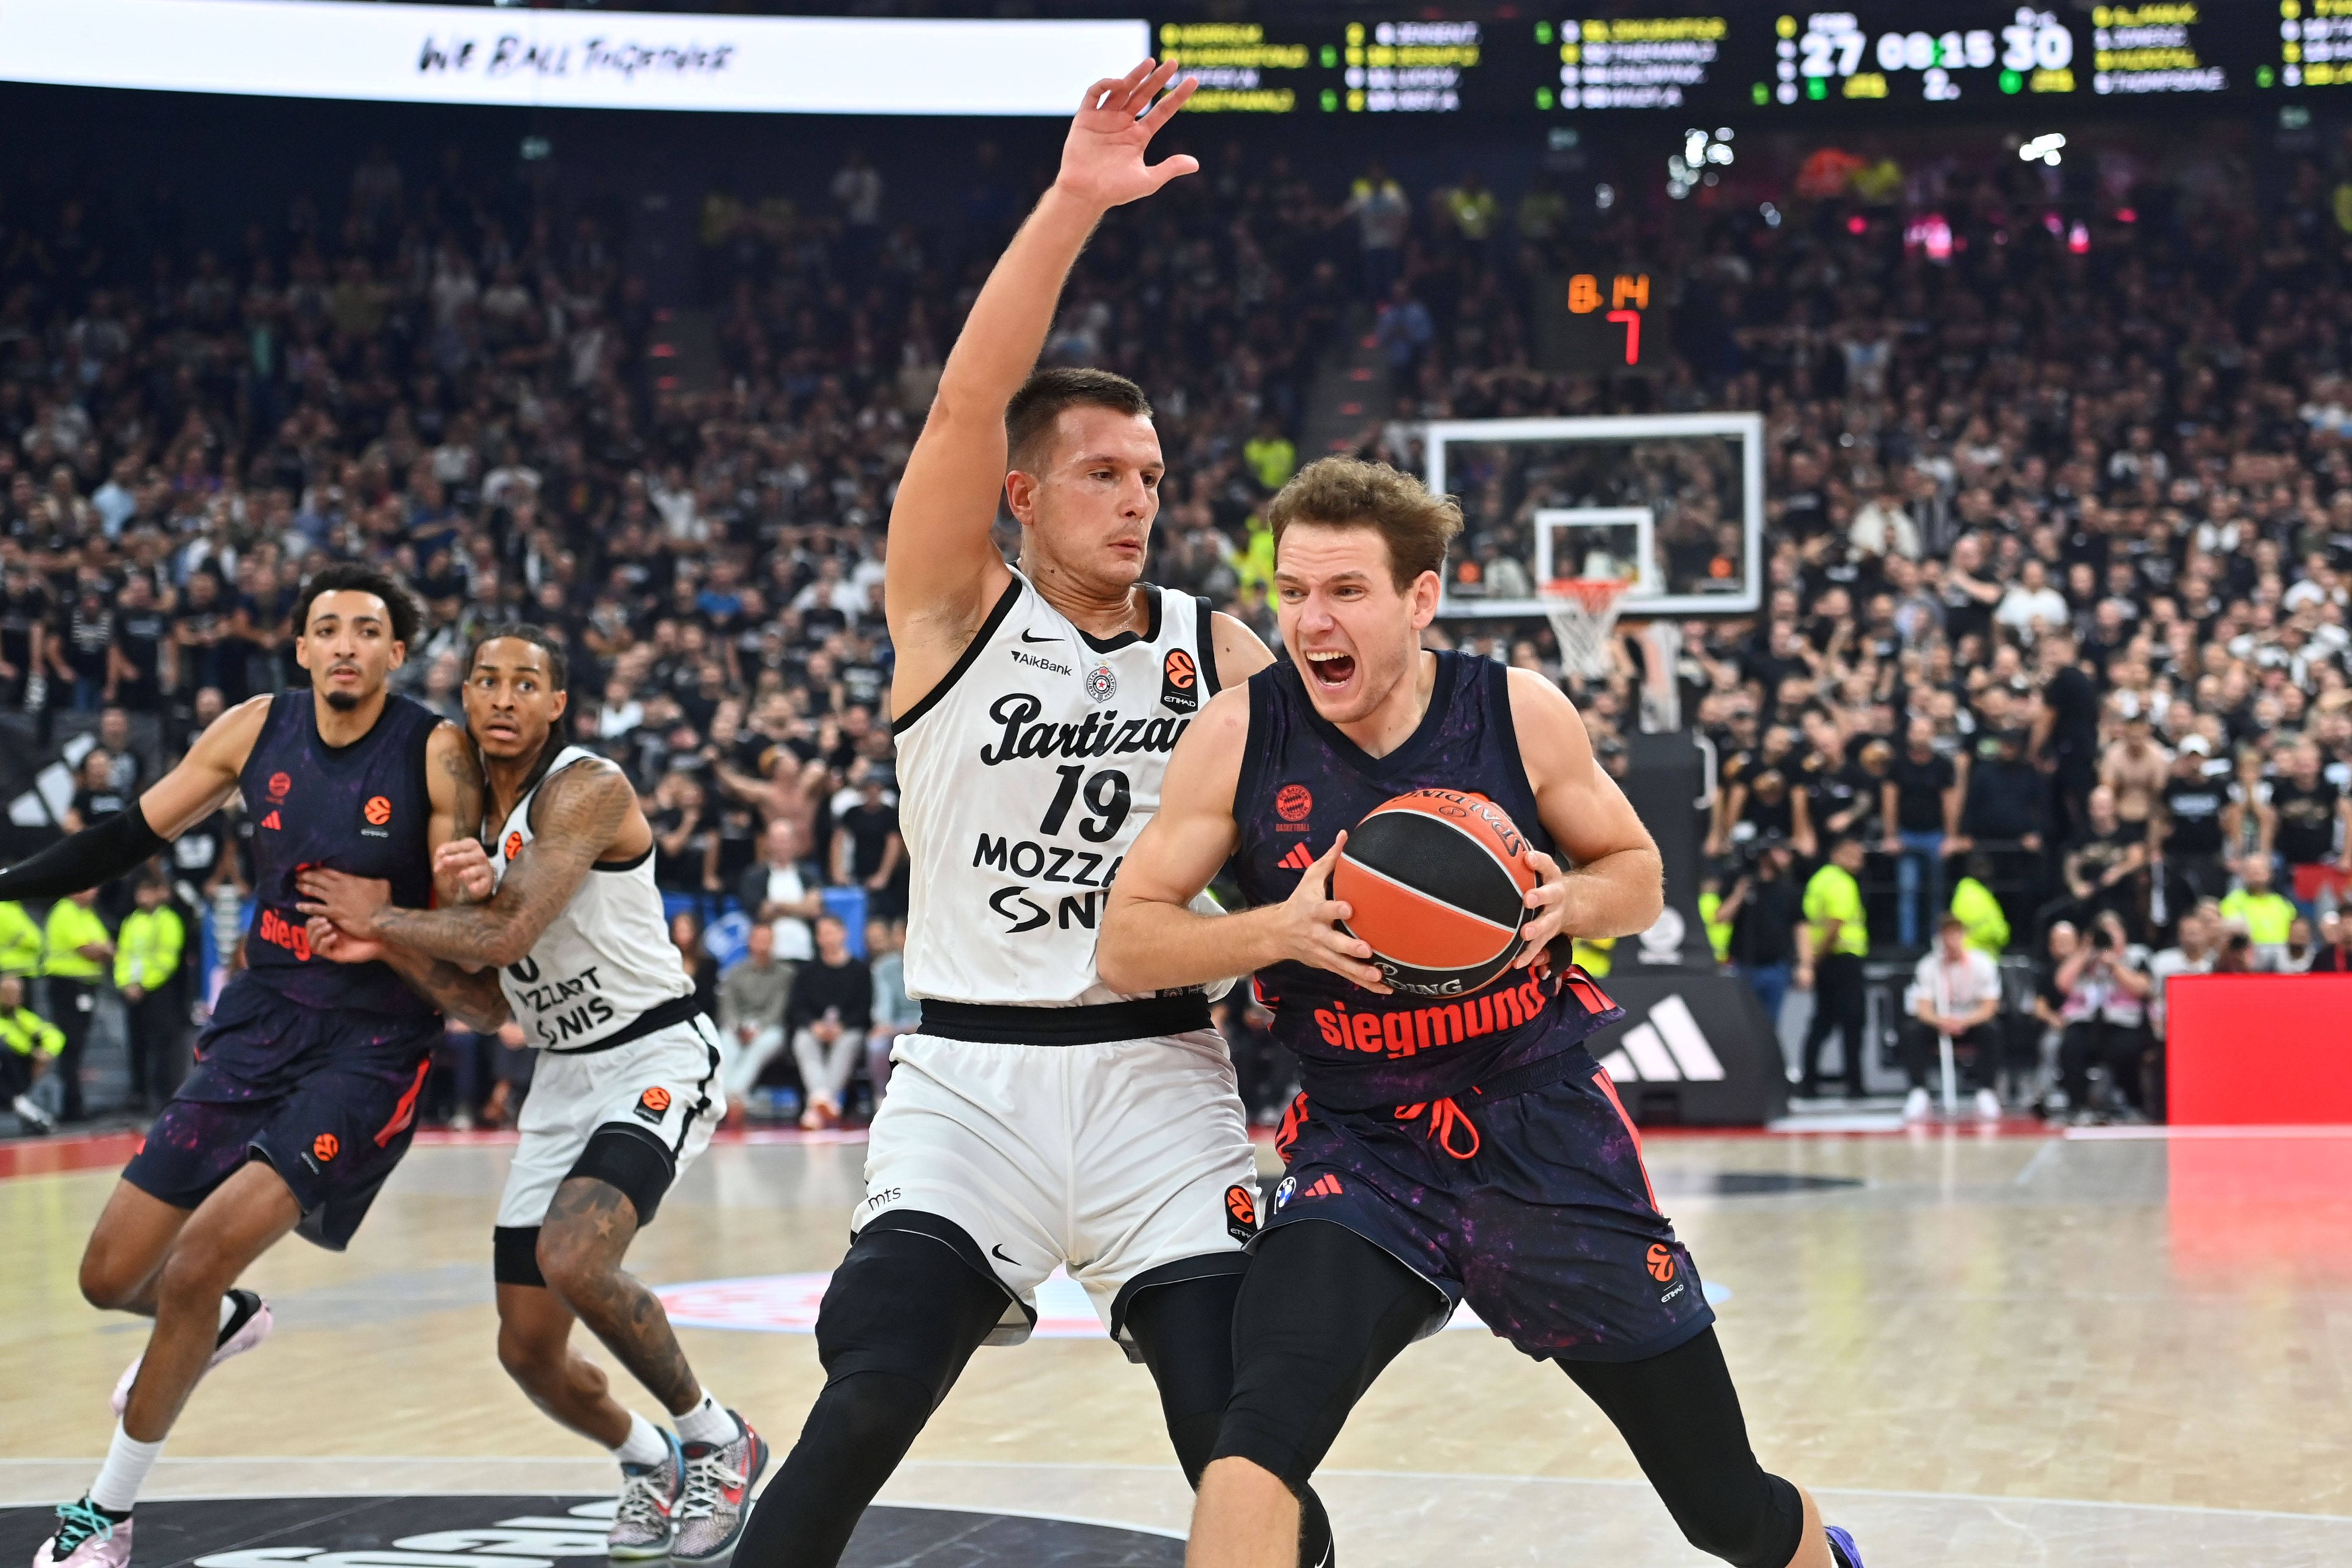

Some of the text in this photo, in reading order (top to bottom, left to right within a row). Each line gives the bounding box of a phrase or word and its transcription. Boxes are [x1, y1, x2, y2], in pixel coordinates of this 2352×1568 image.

[1800, 30, 1866, 76] 27
[2002, 25, 2073, 71] 30
[1606, 310, 1640, 365] 7
[1019, 653, 1072, 676] AikBank
[1164, 695, 1196, 707] ETIHAD
[1040, 765, 1131, 843] 19
[1392, 790, 1526, 858] SPALDING
[1313, 964, 1547, 1060] siegmund
[868, 1187, 901, 1211] mts
[1661, 1284, 1684, 1303] ETIHAD
